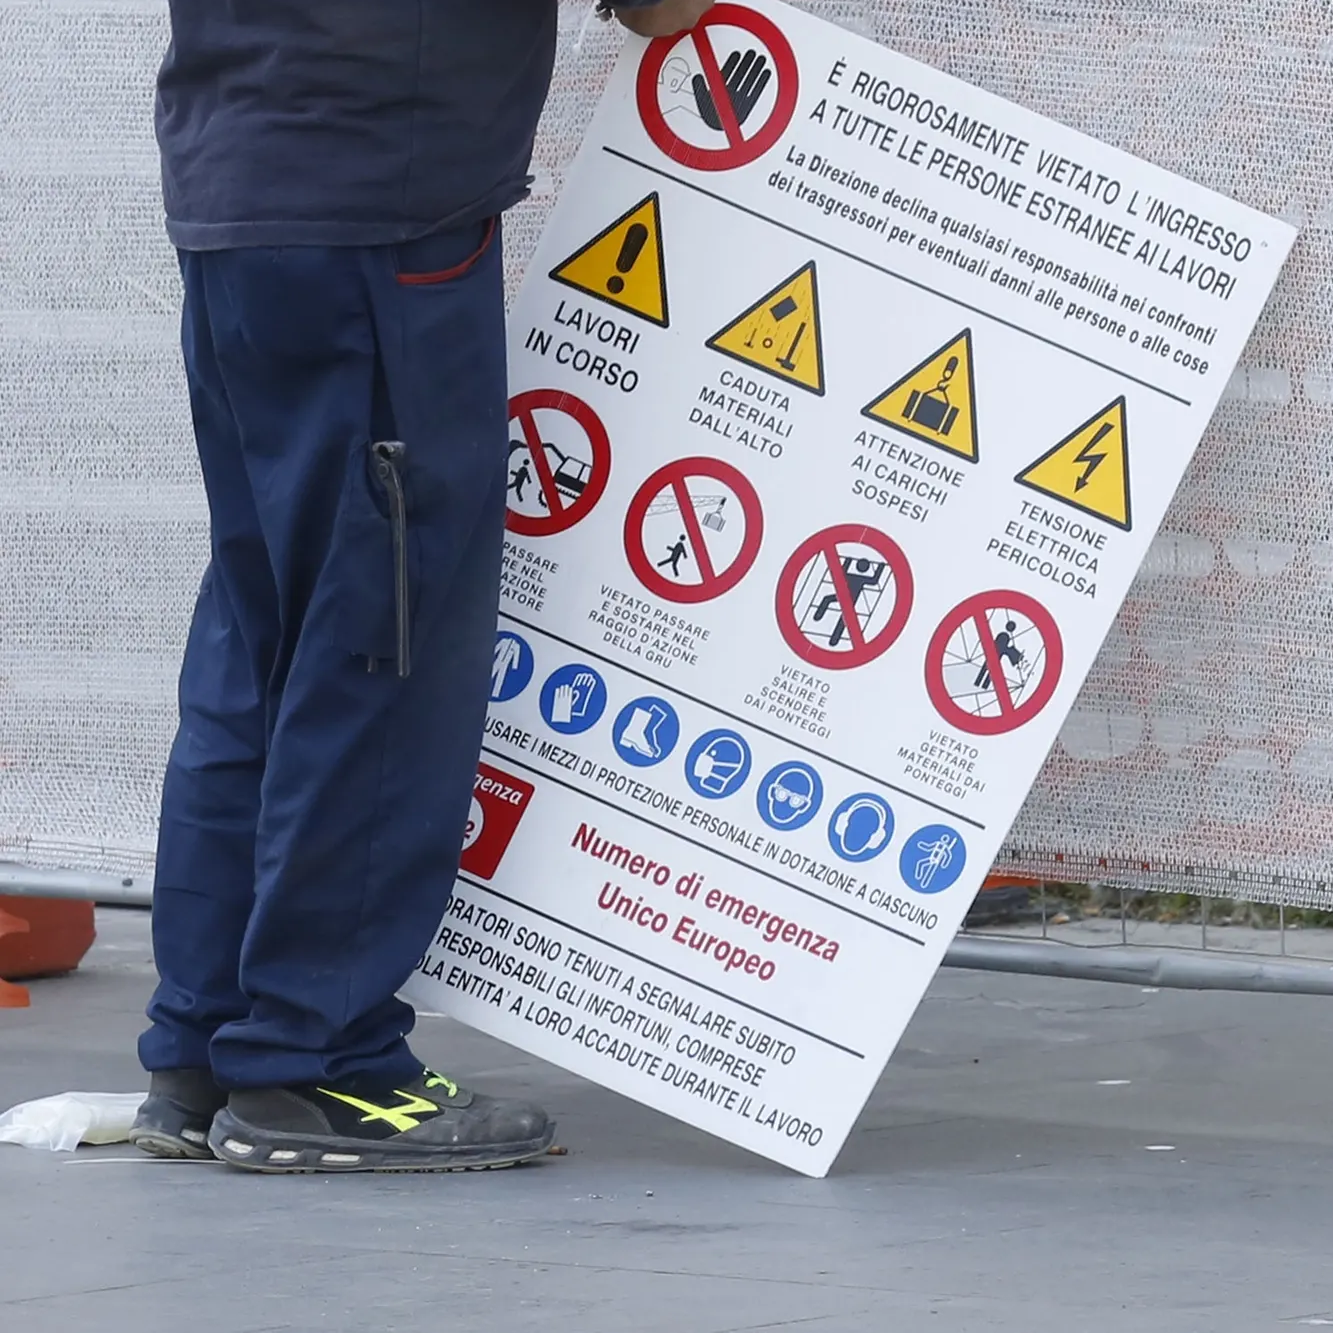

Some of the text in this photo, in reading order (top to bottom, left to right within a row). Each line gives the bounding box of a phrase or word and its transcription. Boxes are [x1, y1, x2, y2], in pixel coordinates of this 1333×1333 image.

[850, 70, 1030, 166] RIGOROSAMENTE
[1036, 149, 1121, 205] VIETATO
[1126, 190, 1252, 263] L'INGRESSO
[809, 98, 1238, 301] A TUTTE LE PERSONE ESTRANEE AI LAVORI
[785, 144, 1218, 346] La Direzione declina qualsiasi responsabilità nei confronti
[767, 170, 1209, 375] dei trasgressori per eventuali danni alle persone o alle cose
[553, 300, 641, 355] LAVORI
[524, 327, 639, 393] IN CORSO
[698, 386, 793, 438] MATERIALI
[719, 370, 790, 413] CADUTA
[688, 407, 783, 459] DALL'ALTO
[854, 430, 965, 488] ATTENZIONE
[851, 454, 948, 506] AI CARICHI
[851, 479, 929, 523] SOSPESI
[1004, 520, 1098, 574] ELETTRICA
[1020, 500, 1108, 551] TENSIONE
[500, 541, 559, 574] PASSARE
[520, 564, 543, 584] NEL
[986, 538, 1097, 599] PERICOLOSA
[588, 609, 698, 665] RAGGIO D'AZIONE
[601, 584, 710, 641] VIETATO PASSARE
[601, 600, 695, 650] E SOSTARE NEL
[602, 631, 673, 669] DELLA GRU
[760, 686, 826, 722] SCENDERE
[771, 676, 826, 708] SALIRE E
[781, 664, 830, 694] VIETATO
[744, 694, 831, 739] DAI PONTEGGI
[897, 747, 986, 792] MATERIALI DAI
[920, 742, 975, 773] GETTARE
[929, 730, 979, 759] VIETATO
[903, 764, 967, 799] PONTEGGI
[483, 717, 938, 930] USARE I MEZZI DI PROTEZIONE PERSONALE IN DOTAZIONE A CIASCUNO
[570, 822, 840, 963] Numero di emergenza
[597, 881, 776, 981] Unico Europeo
[435, 925, 767, 1088] RESPONSABILI GLI INFORTUNI, COMPRESE
[512, 926, 562, 962] SONO
[563, 947, 623, 989] TENUTI
[619, 975, 635, 996] A
[636, 981, 737, 1040] SEGNALARE
[734, 1025, 796, 1066] SUBITO
[445, 965, 512, 1008] ENTITA'
[508, 995, 524, 1016] A
[524, 1000, 573, 1036] LORO
[571, 1023, 663, 1077] ACCADUTE
[660, 1062, 740, 1111] DURANTE
[737, 1095, 753, 1119] IL
[754, 1104, 823, 1147] LAVORO
